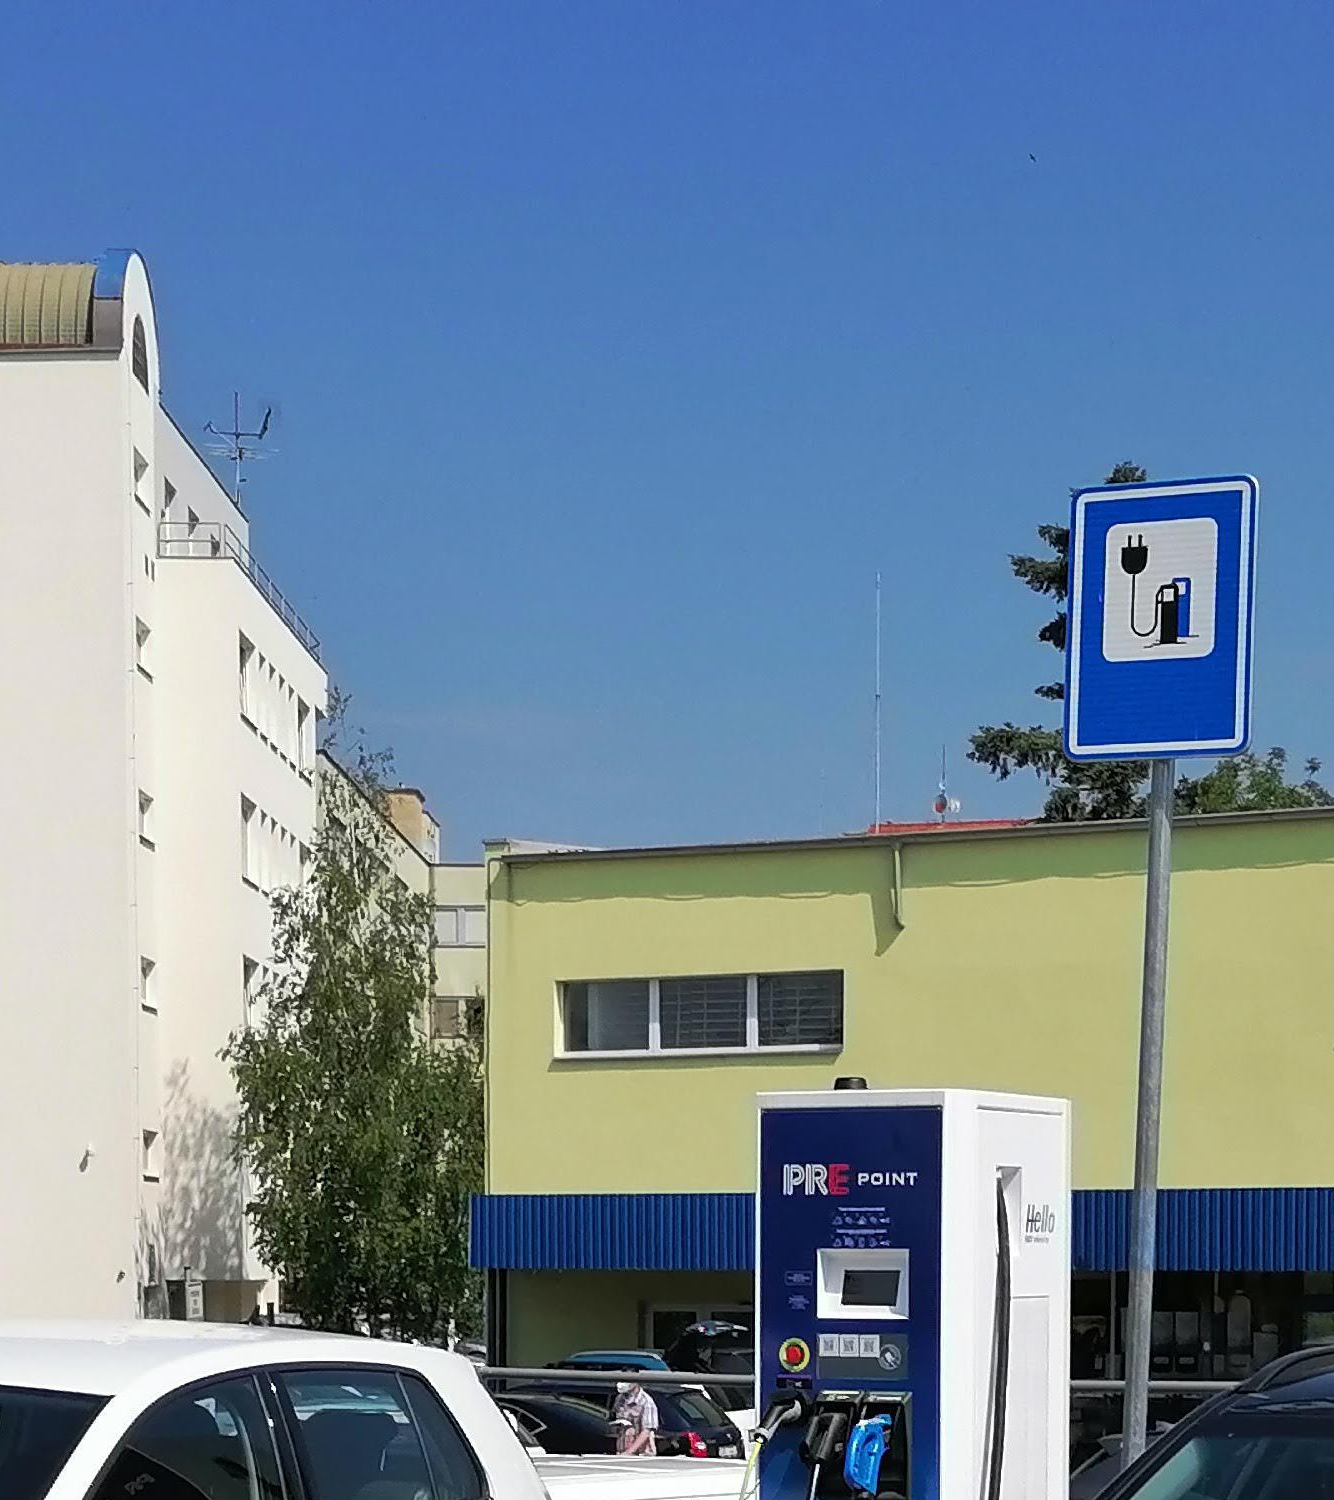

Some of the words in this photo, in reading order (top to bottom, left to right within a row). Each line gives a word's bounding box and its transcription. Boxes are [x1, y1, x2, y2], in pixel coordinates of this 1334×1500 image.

[782, 1163, 850, 1196] PRE
[857, 1172, 918, 1186] POINT
[1025, 1203, 1056, 1233] Hello
